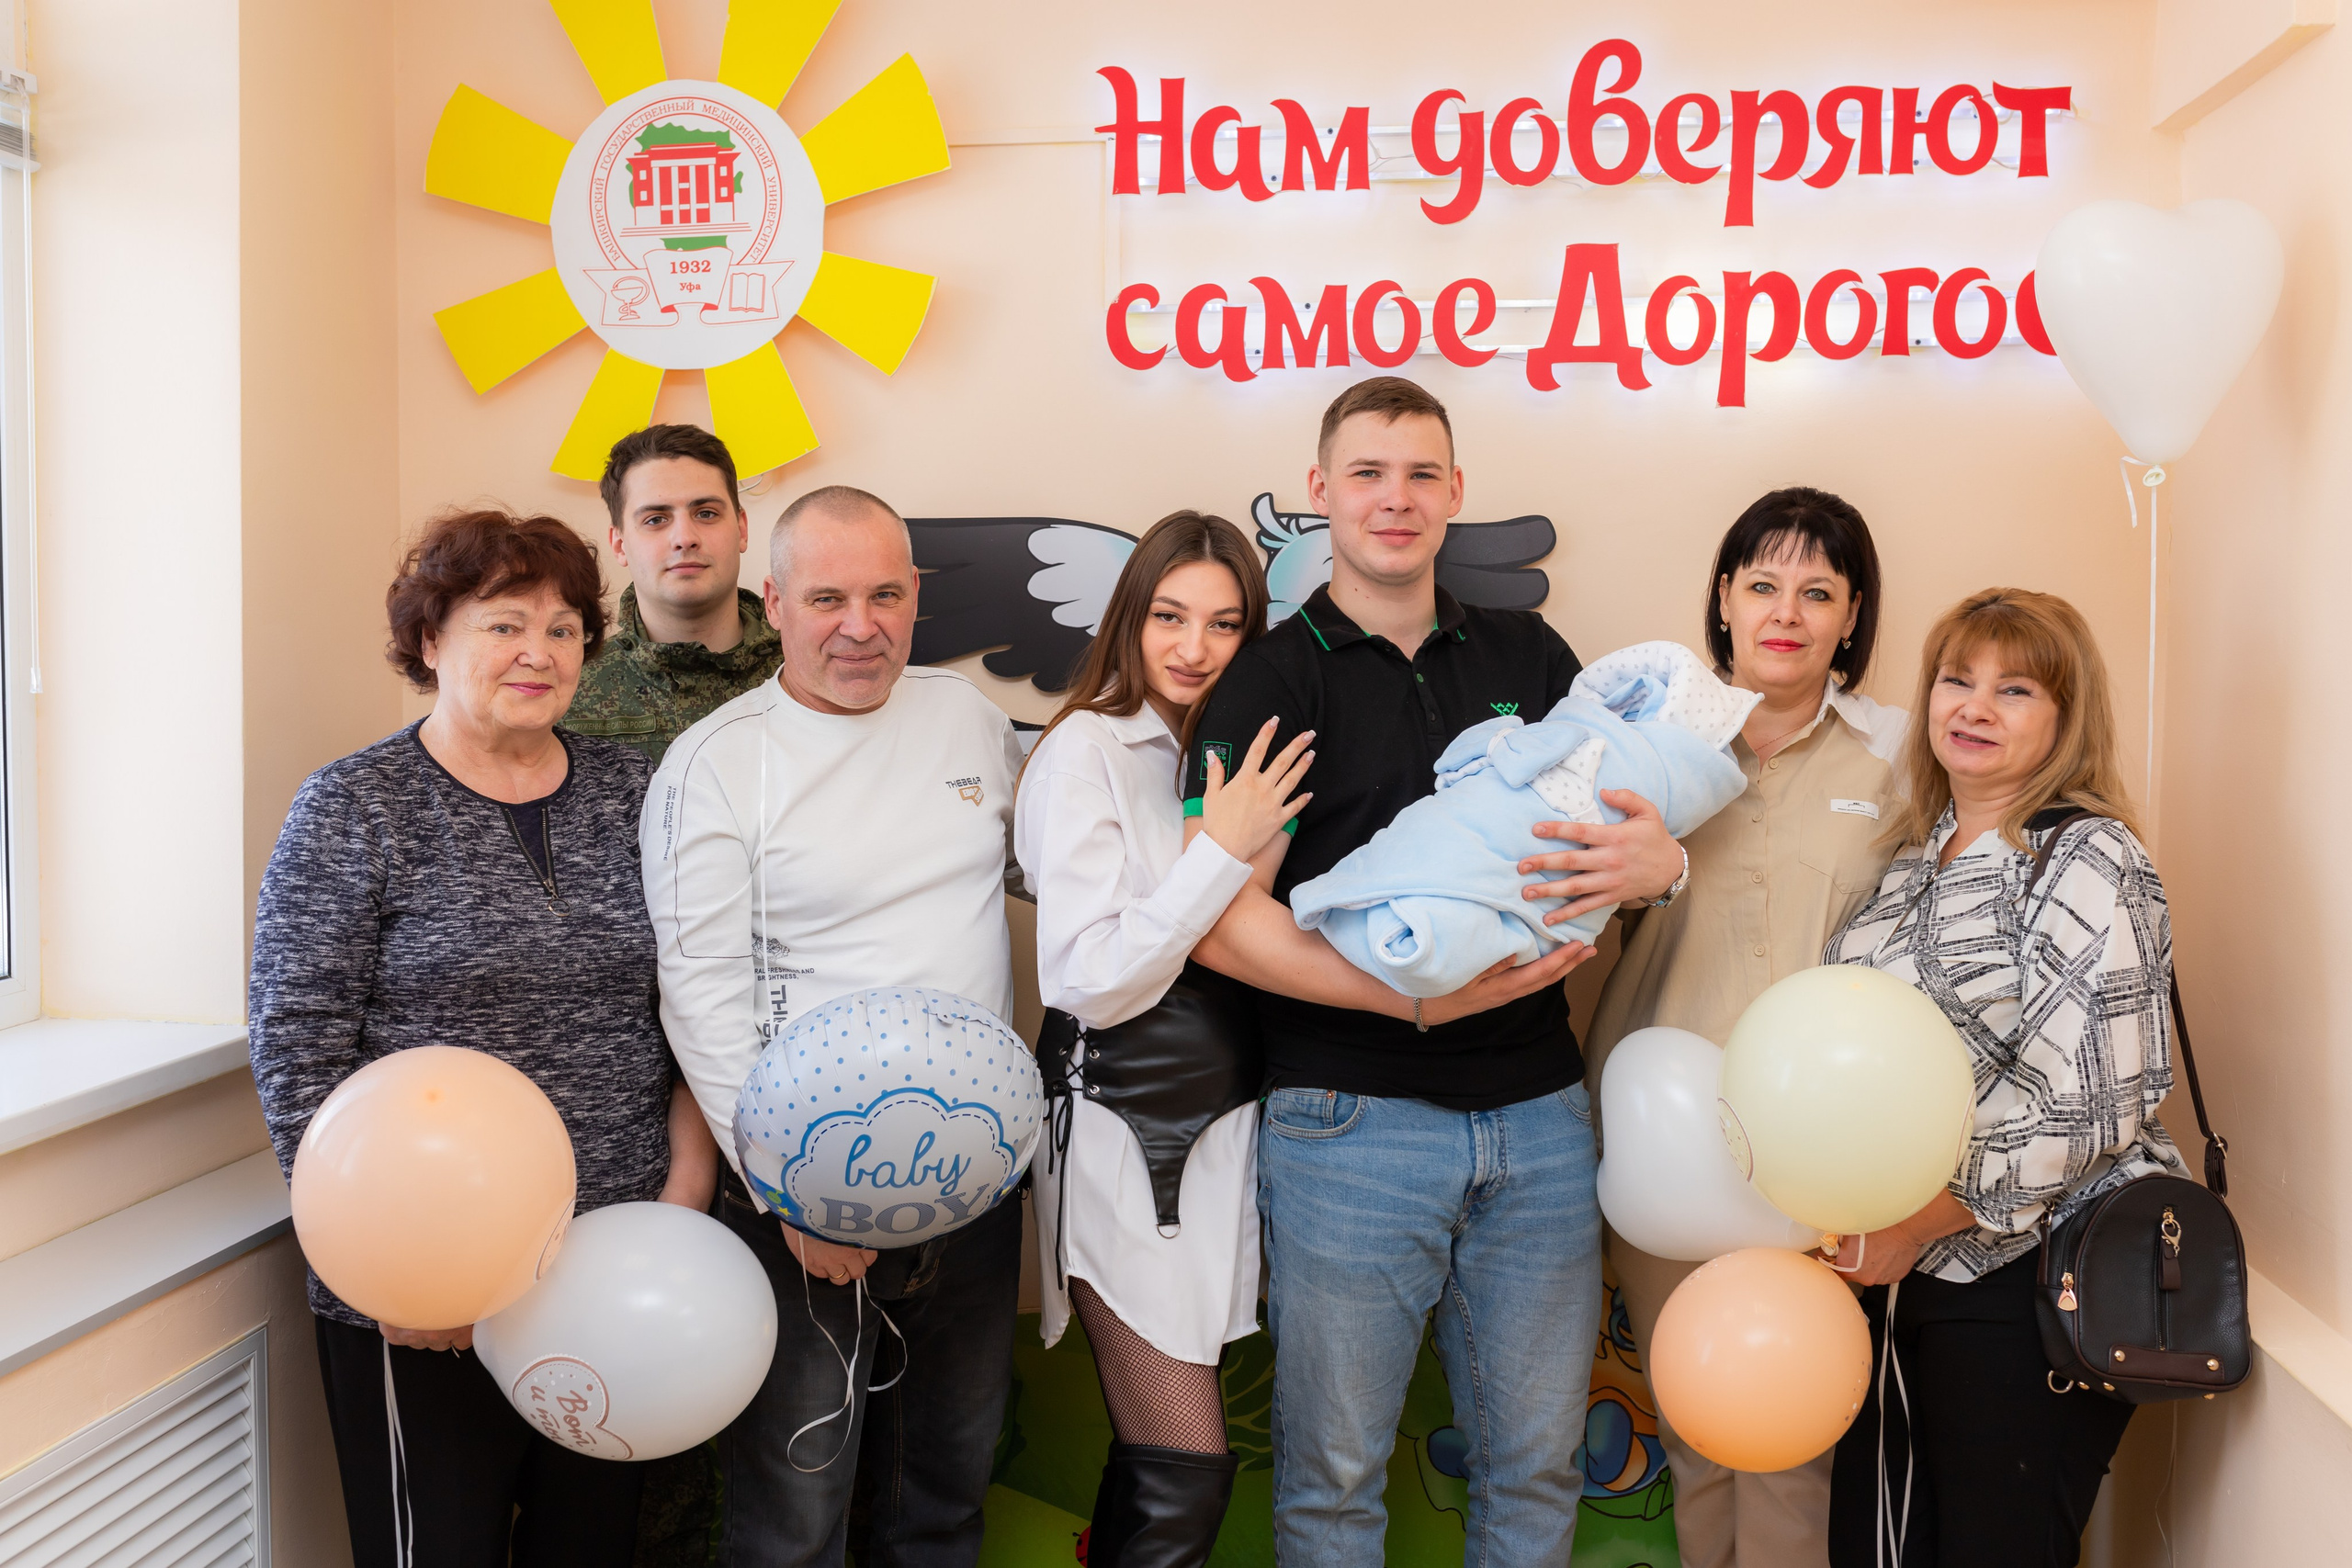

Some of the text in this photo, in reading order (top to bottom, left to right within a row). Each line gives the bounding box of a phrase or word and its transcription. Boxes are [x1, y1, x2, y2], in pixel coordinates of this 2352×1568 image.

[1094, 39, 2073, 228] Нам доверяют
[594, 98, 778, 263] БАШКИРСКИЙ ГОСУДАРСТВЕННЫЙ МЕДИЦИНСКИЙ УНИВЕРСИТЕТ
[670, 260, 711, 274] 1932
[679, 282, 701, 293] Уфа
[1105, 276, 1501, 383] самое
[611, 720, 628, 729] СИЛЫ
[629, 718, 654, 729] РОССИИ
[844, 1131, 972, 1197] baby
[820, 1182, 990, 1235] BOY
[556, 1389, 597, 1447] Вот
